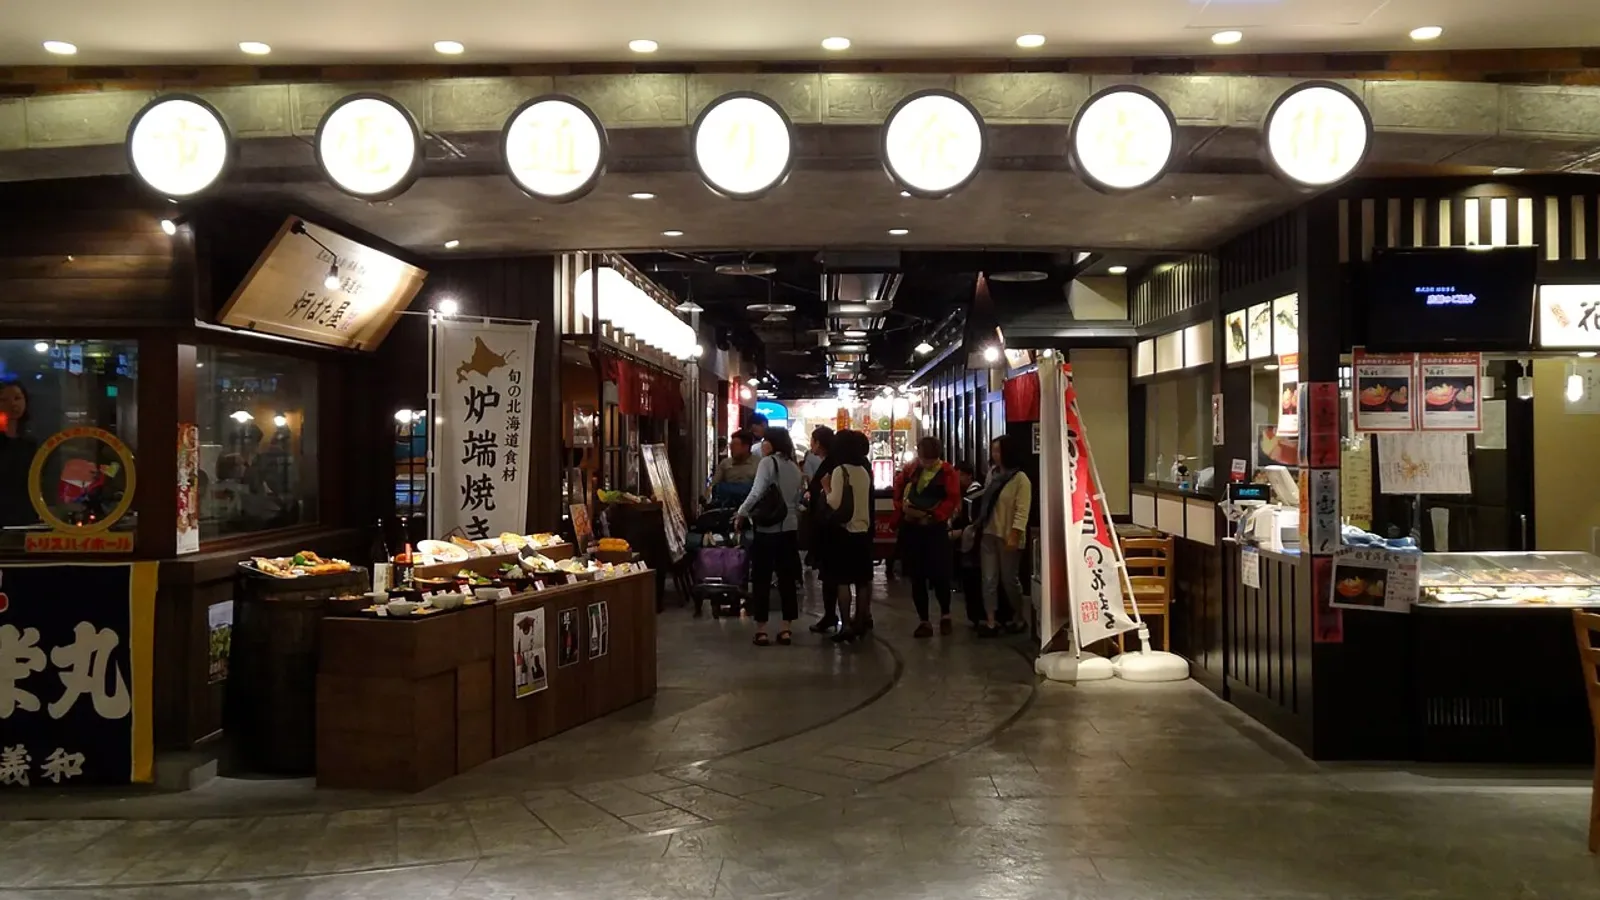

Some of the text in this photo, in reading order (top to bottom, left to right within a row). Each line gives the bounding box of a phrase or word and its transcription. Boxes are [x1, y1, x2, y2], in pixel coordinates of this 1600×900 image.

[286, 289, 352, 329] 炉ばた屋
[460, 384, 501, 540] 炉端焼き
[501, 368, 522, 482] 旬の北海道食材
